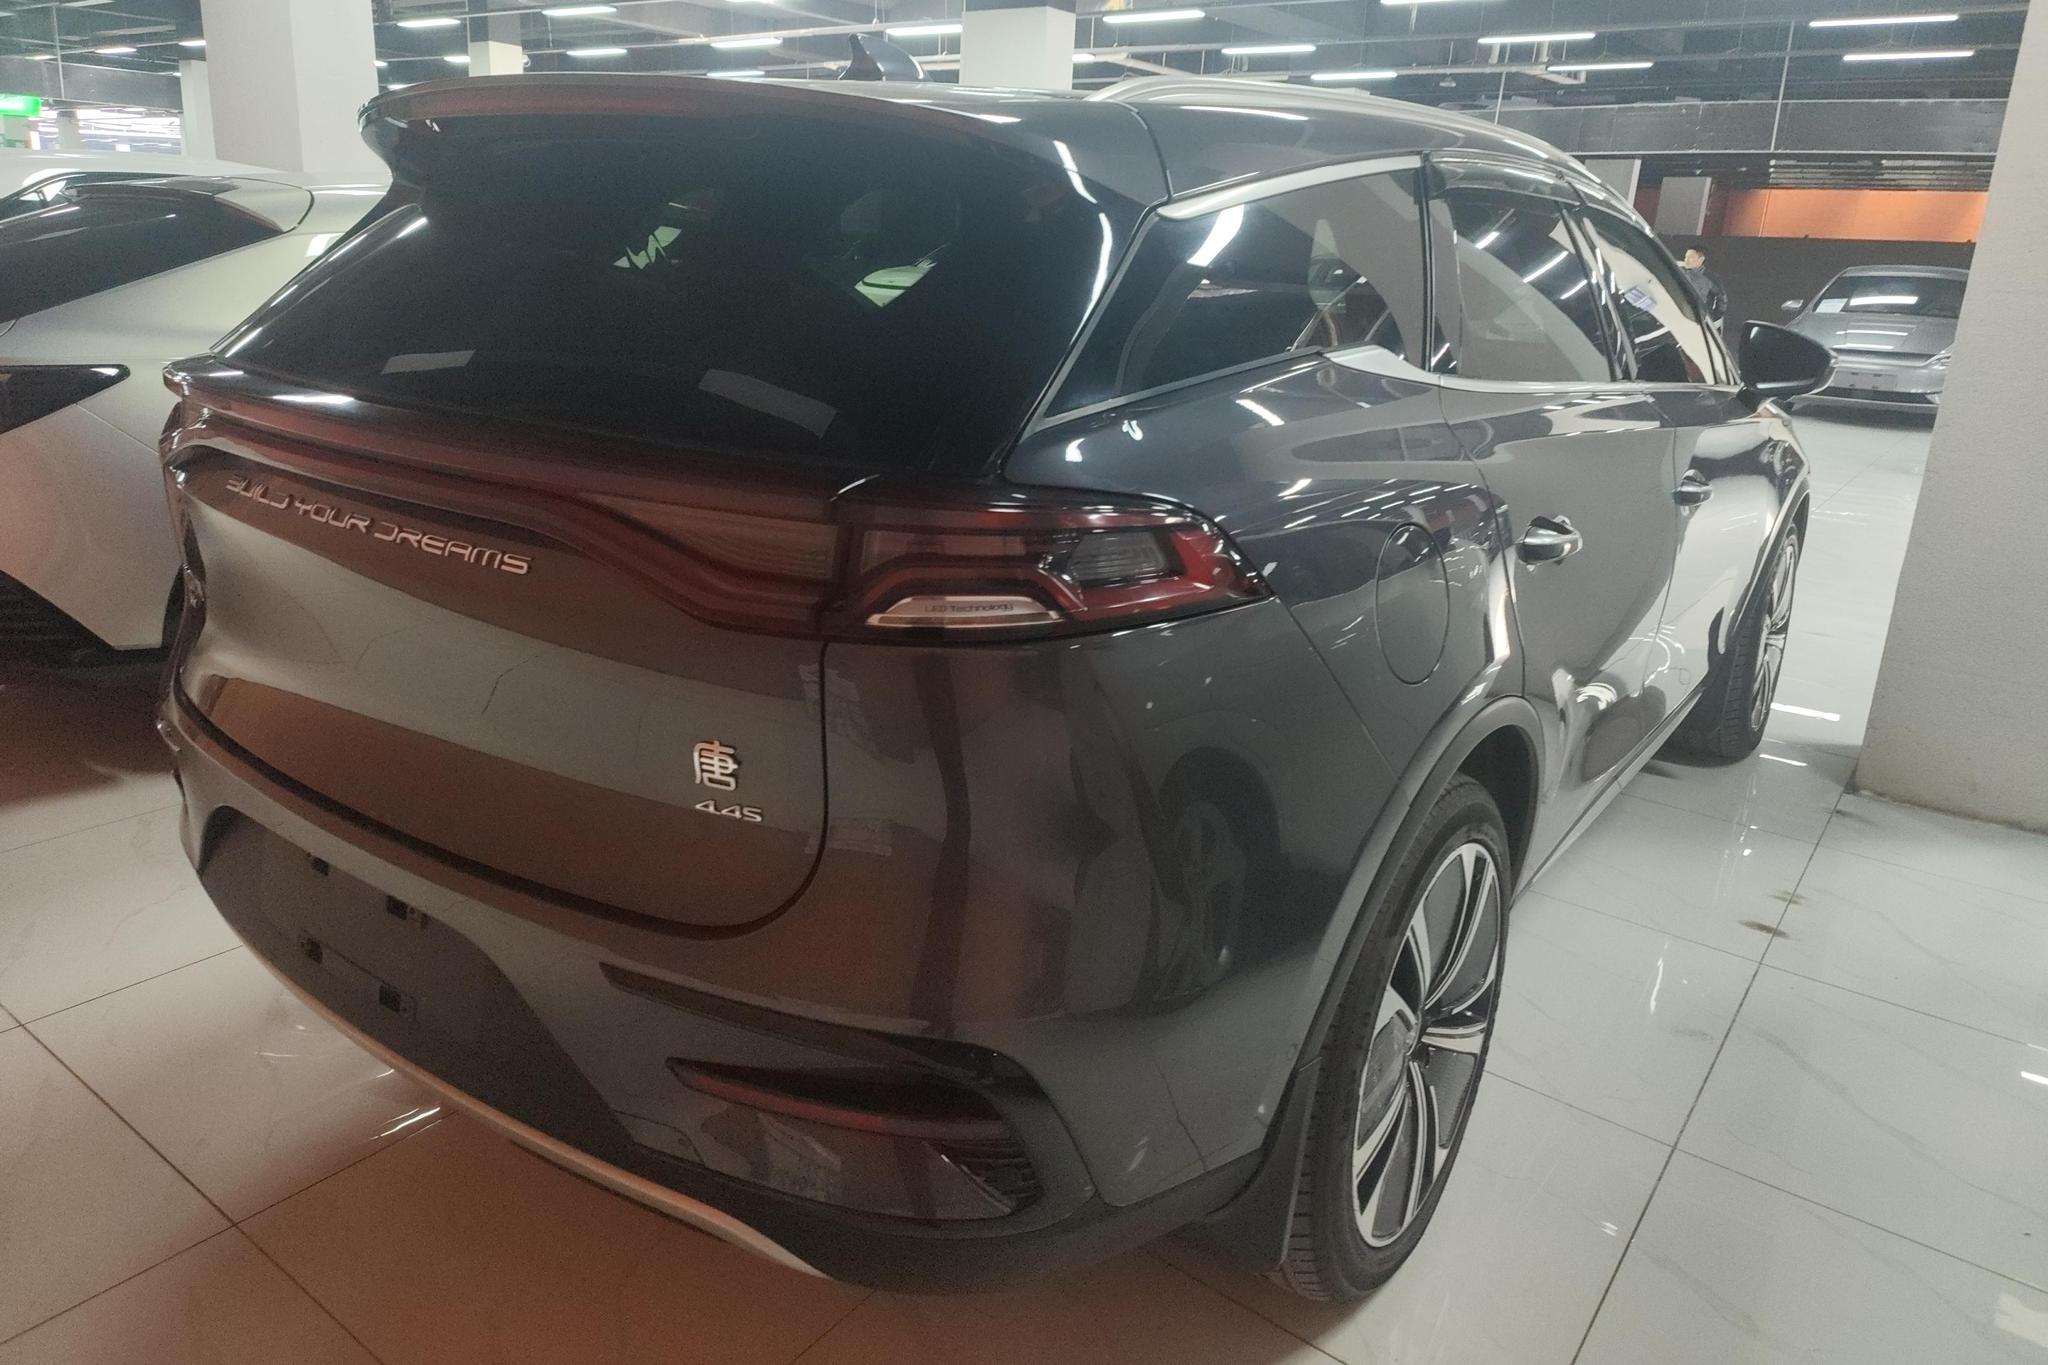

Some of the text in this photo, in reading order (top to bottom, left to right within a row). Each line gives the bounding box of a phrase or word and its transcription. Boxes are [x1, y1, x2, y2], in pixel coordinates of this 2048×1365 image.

[225, 475, 532, 575] BUILD YOUR DREAMS
[948, 603, 1014, 613] Technology
[693, 740, 739, 791] 唐
